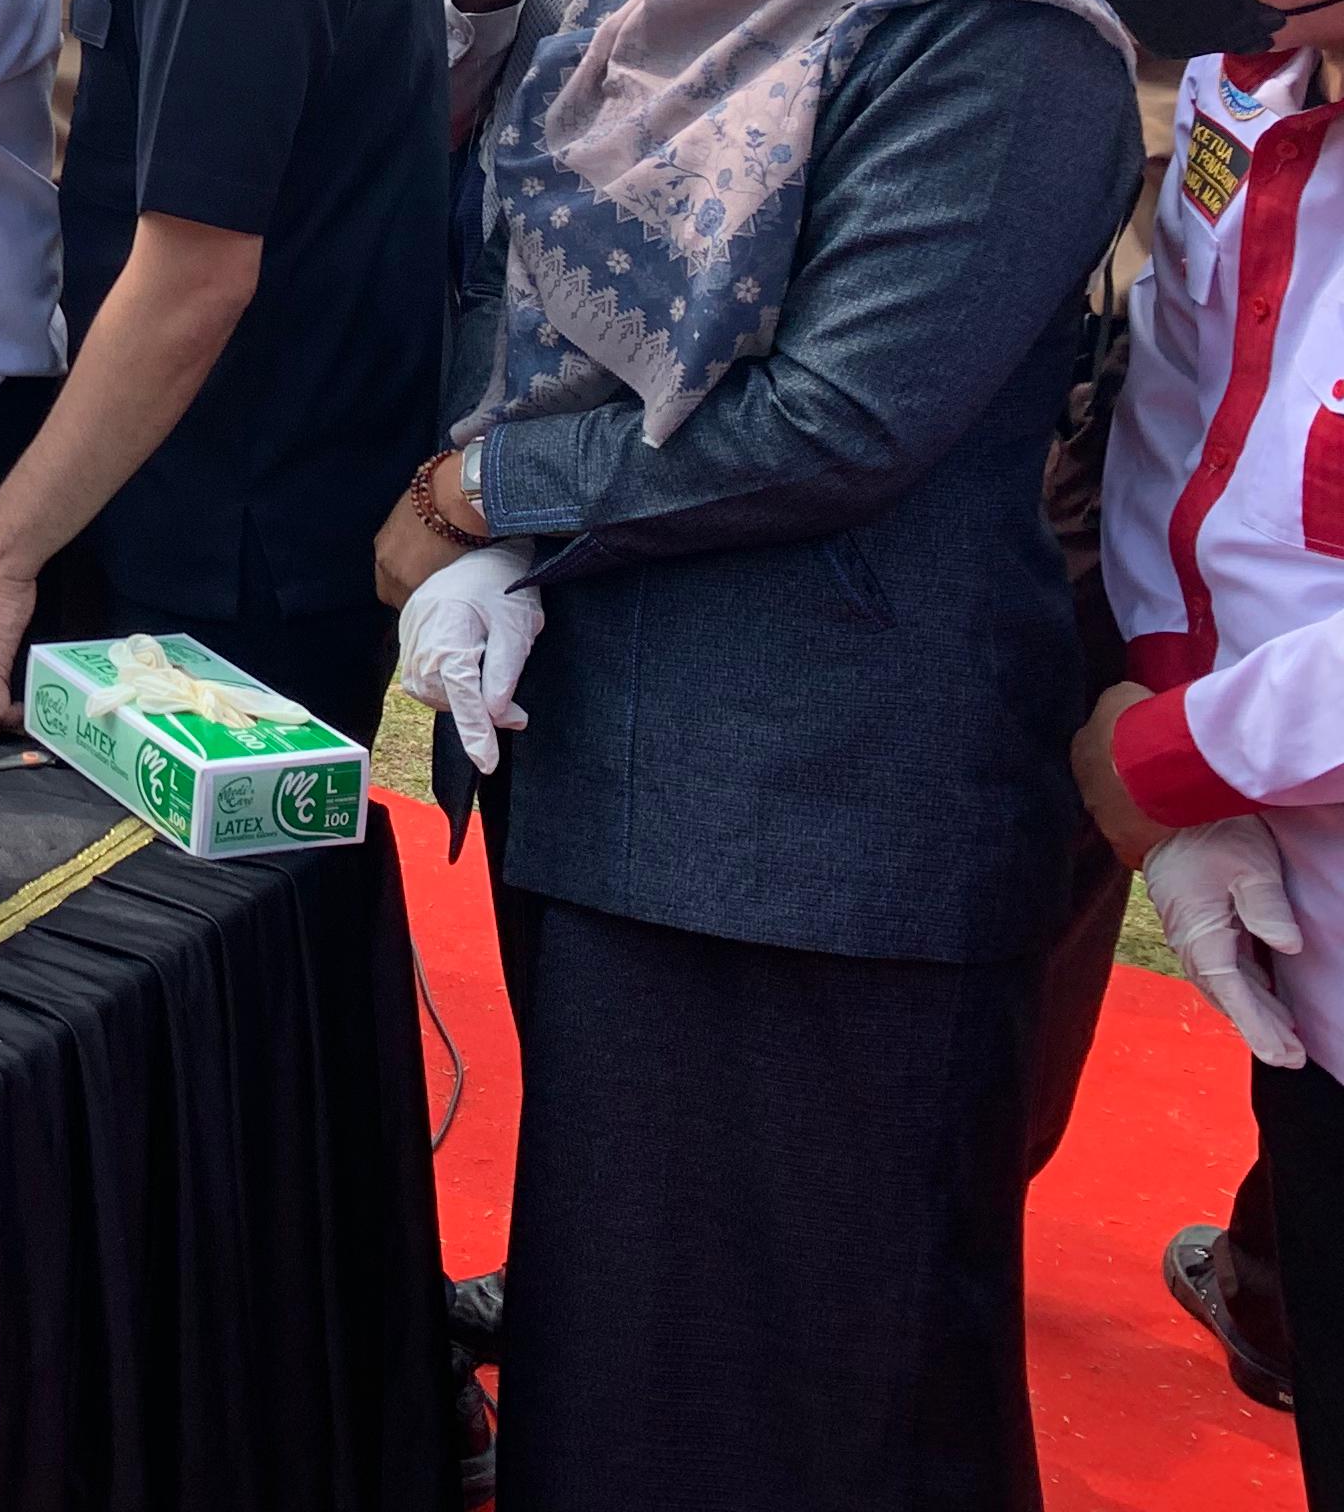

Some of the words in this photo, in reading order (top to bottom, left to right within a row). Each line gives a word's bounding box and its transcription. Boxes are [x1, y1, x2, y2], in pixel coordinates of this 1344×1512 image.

[1192, 122, 1234, 164] KETUA
[77, 714, 117, 760] LATEX
[169, 768, 179, 791] L
[327, 775, 338, 794] L
[168, 808, 186, 831] 100
[216, 817, 263, 836] LATEX
[324, 812, 350, 827] 100
